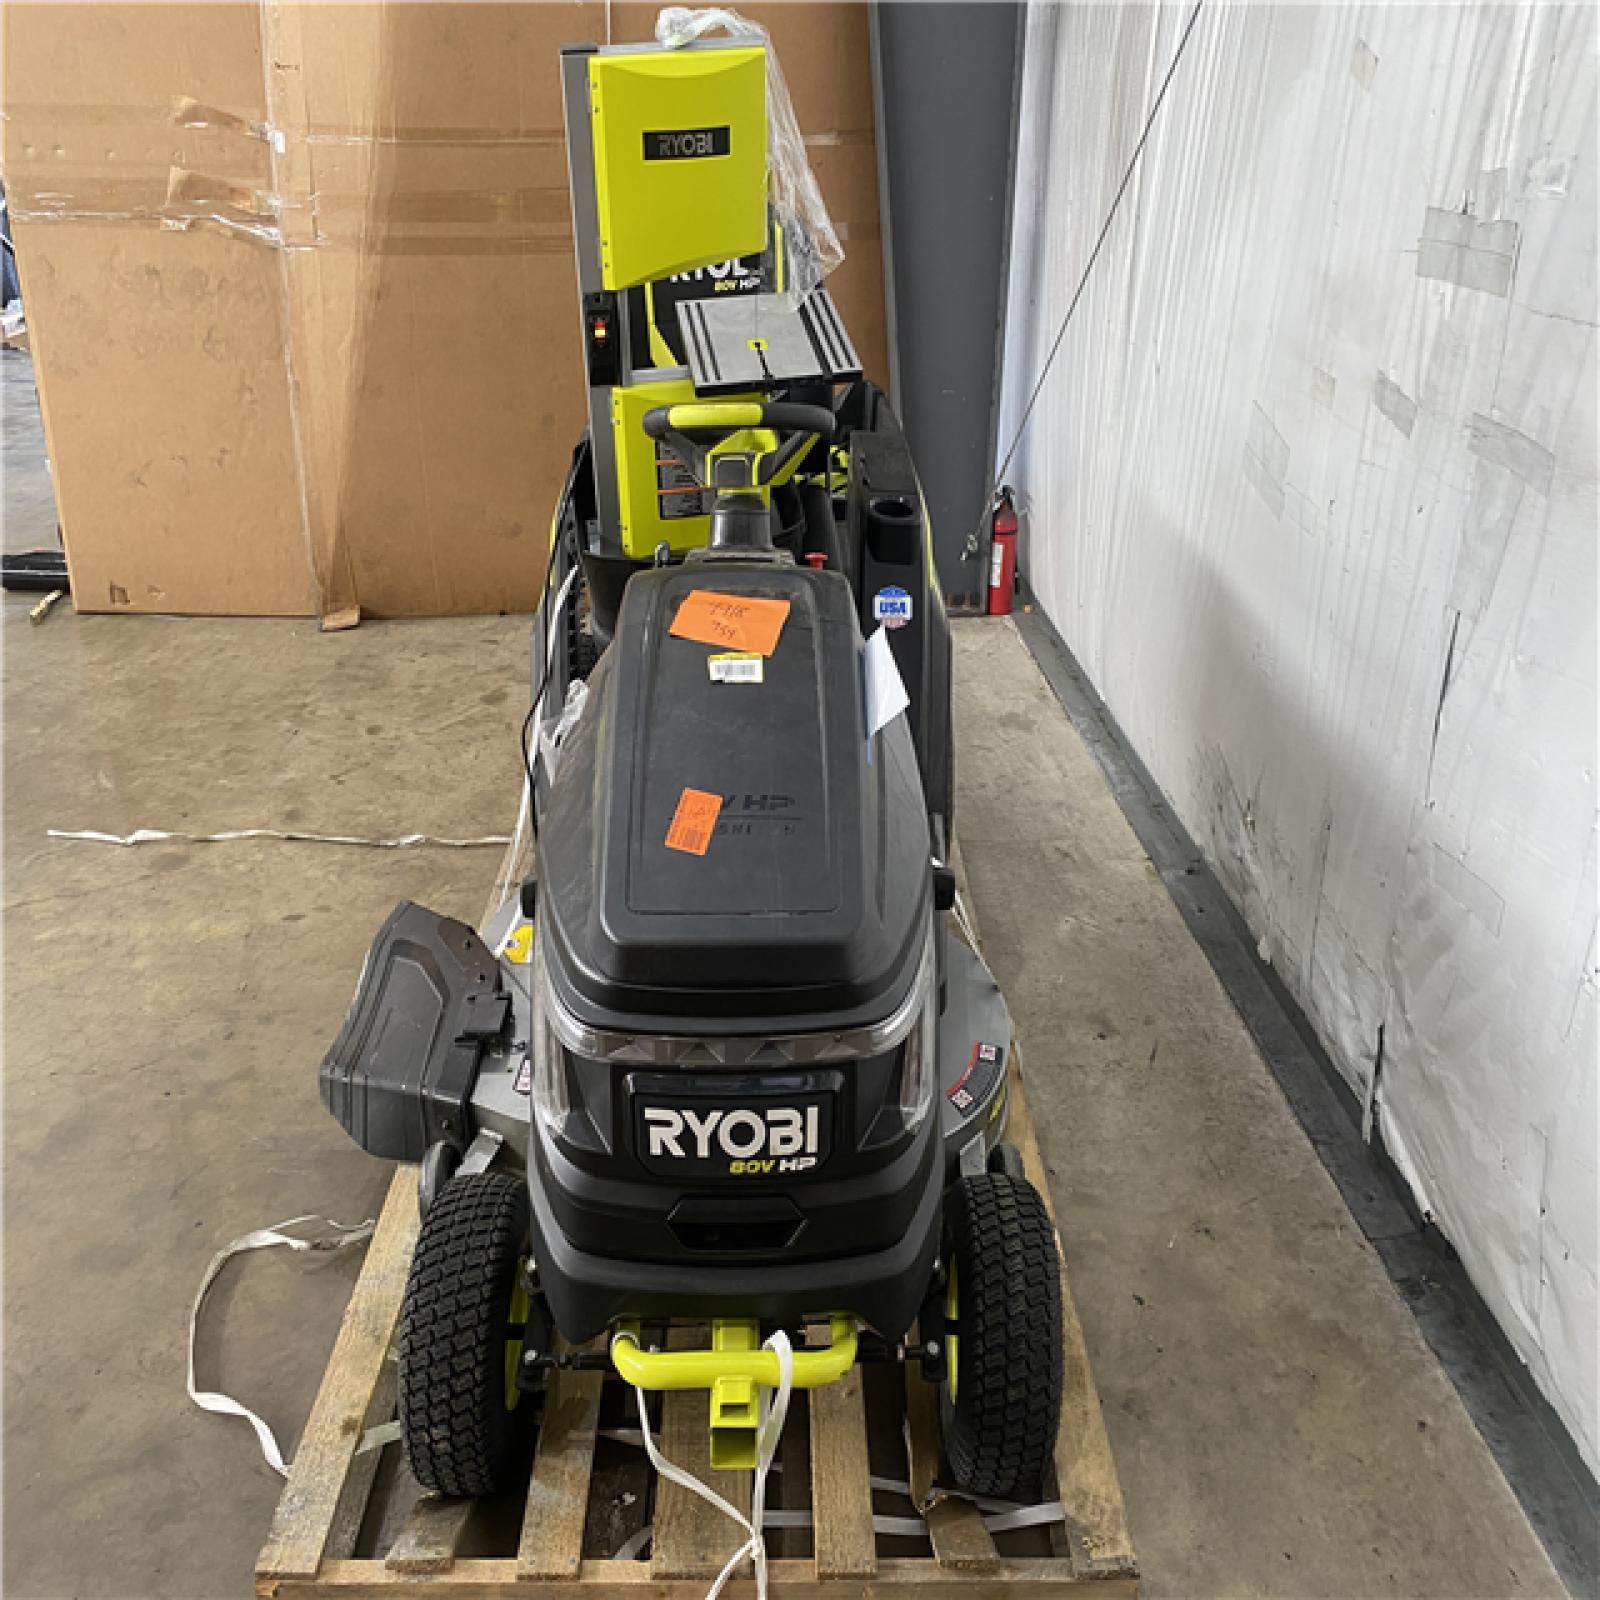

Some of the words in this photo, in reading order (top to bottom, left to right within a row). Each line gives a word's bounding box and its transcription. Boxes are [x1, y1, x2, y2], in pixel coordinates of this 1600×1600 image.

[657, 132, 714, 156] RYOBI
[879, 601, 906, 614] USA
[644, 1106, 818, 1159] RYOBI
[729, 1159, 776, 1175] 80V
[779, 1156, 817, 1173] HP
